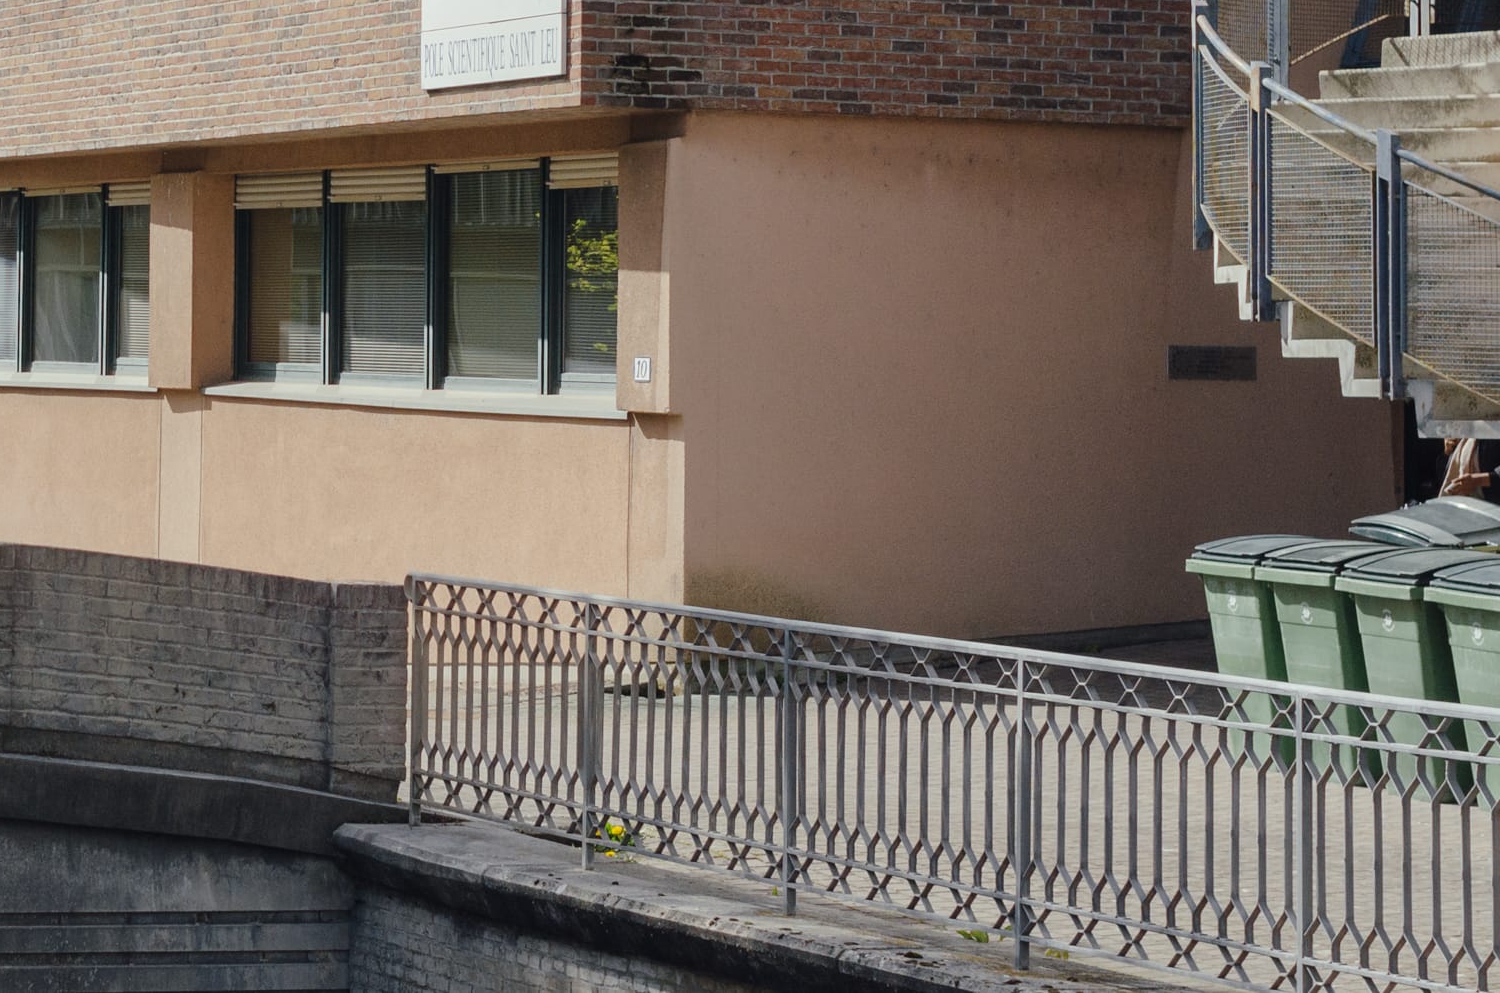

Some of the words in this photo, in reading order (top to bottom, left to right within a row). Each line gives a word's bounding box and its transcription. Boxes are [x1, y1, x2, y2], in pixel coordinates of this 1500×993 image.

[424, 42, 444, 79] POLE
[448, 34, 506, 79] SCIENTIFIQUE
[509, 30, 537, 69] SAINT
[540, 27, 559, 65] LEU
[636, 360, 648, 379] 10
